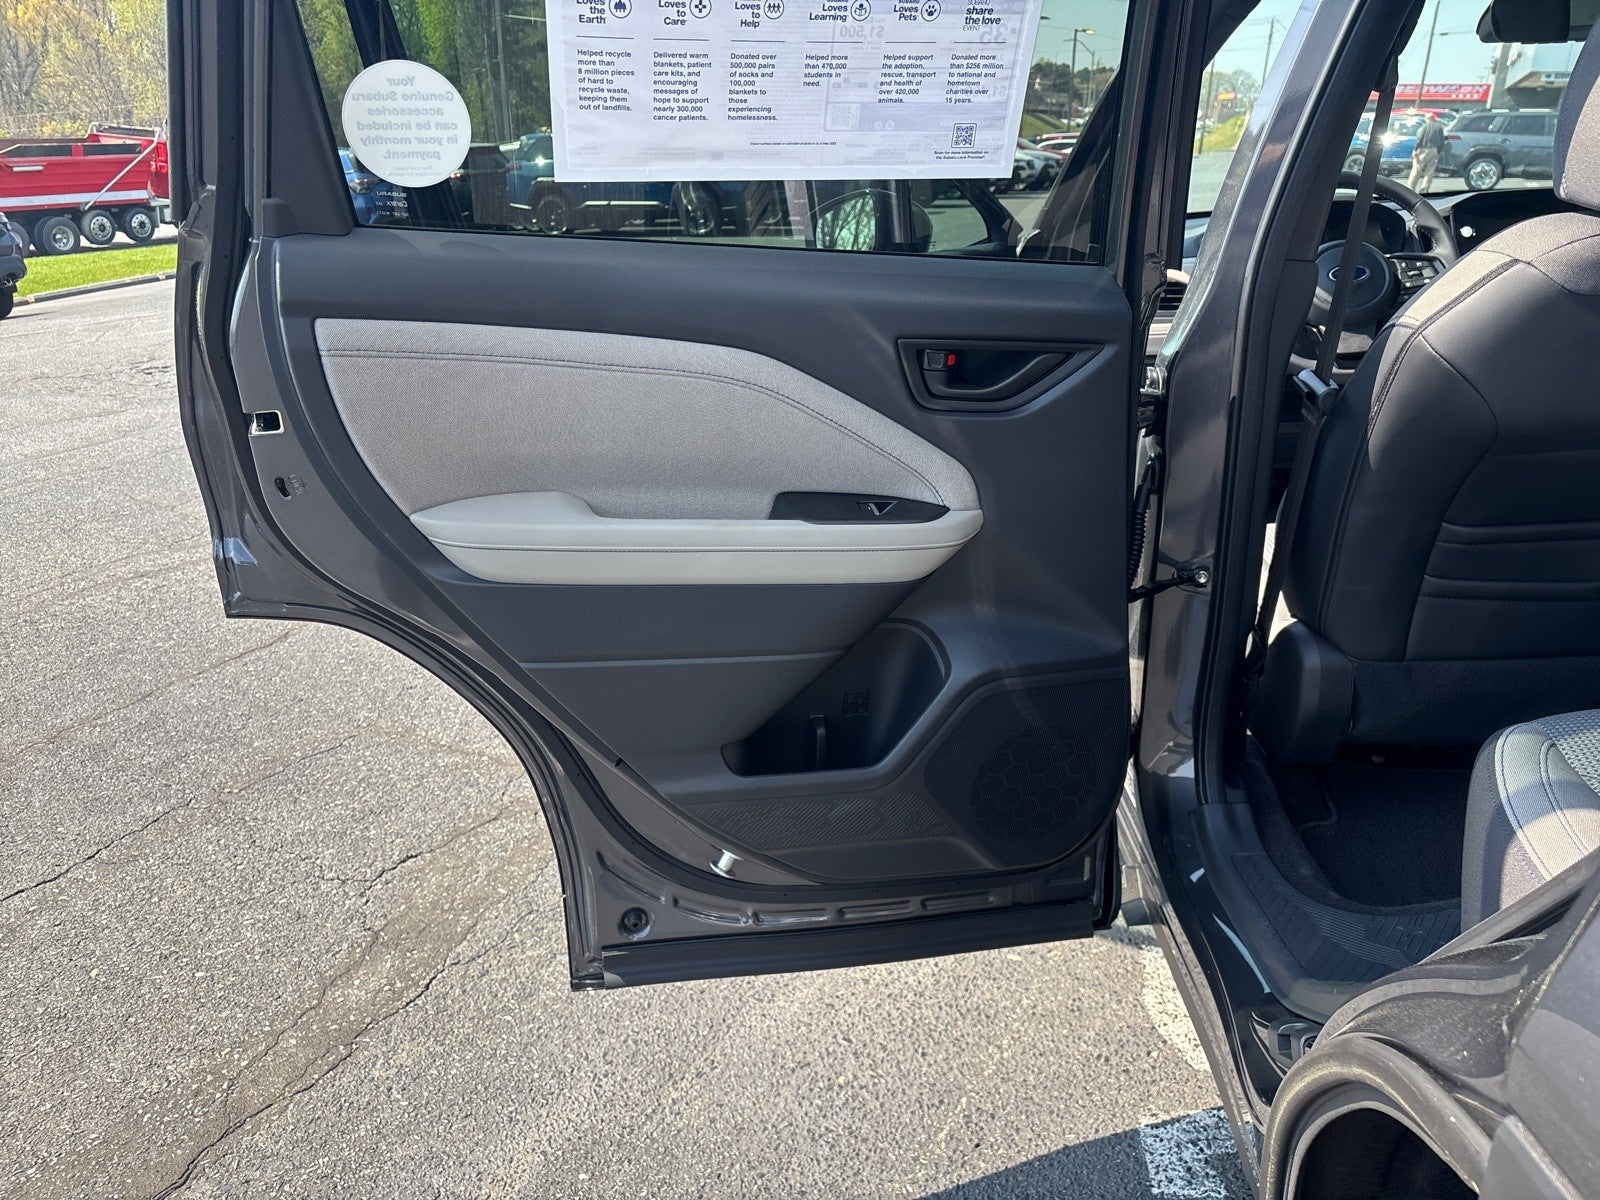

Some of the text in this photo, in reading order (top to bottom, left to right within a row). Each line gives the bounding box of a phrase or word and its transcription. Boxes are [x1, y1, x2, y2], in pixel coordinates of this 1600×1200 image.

[659, 0, 686, 8] Loves
[735, 2, 761, 10] Loves
[822, 3, 848, 12] Loves
[590, 6, 605, 14] the
[966, 6, 994, 15] share
[579, 15, 606, 24] Earth
[664, 17, 686, 26] Care
[809, 13, 847, 22] Learning
[965, 16, 1001, 25] the love
[740, 20, 760, 28] Help
[688, 61, 712, 69] patient
